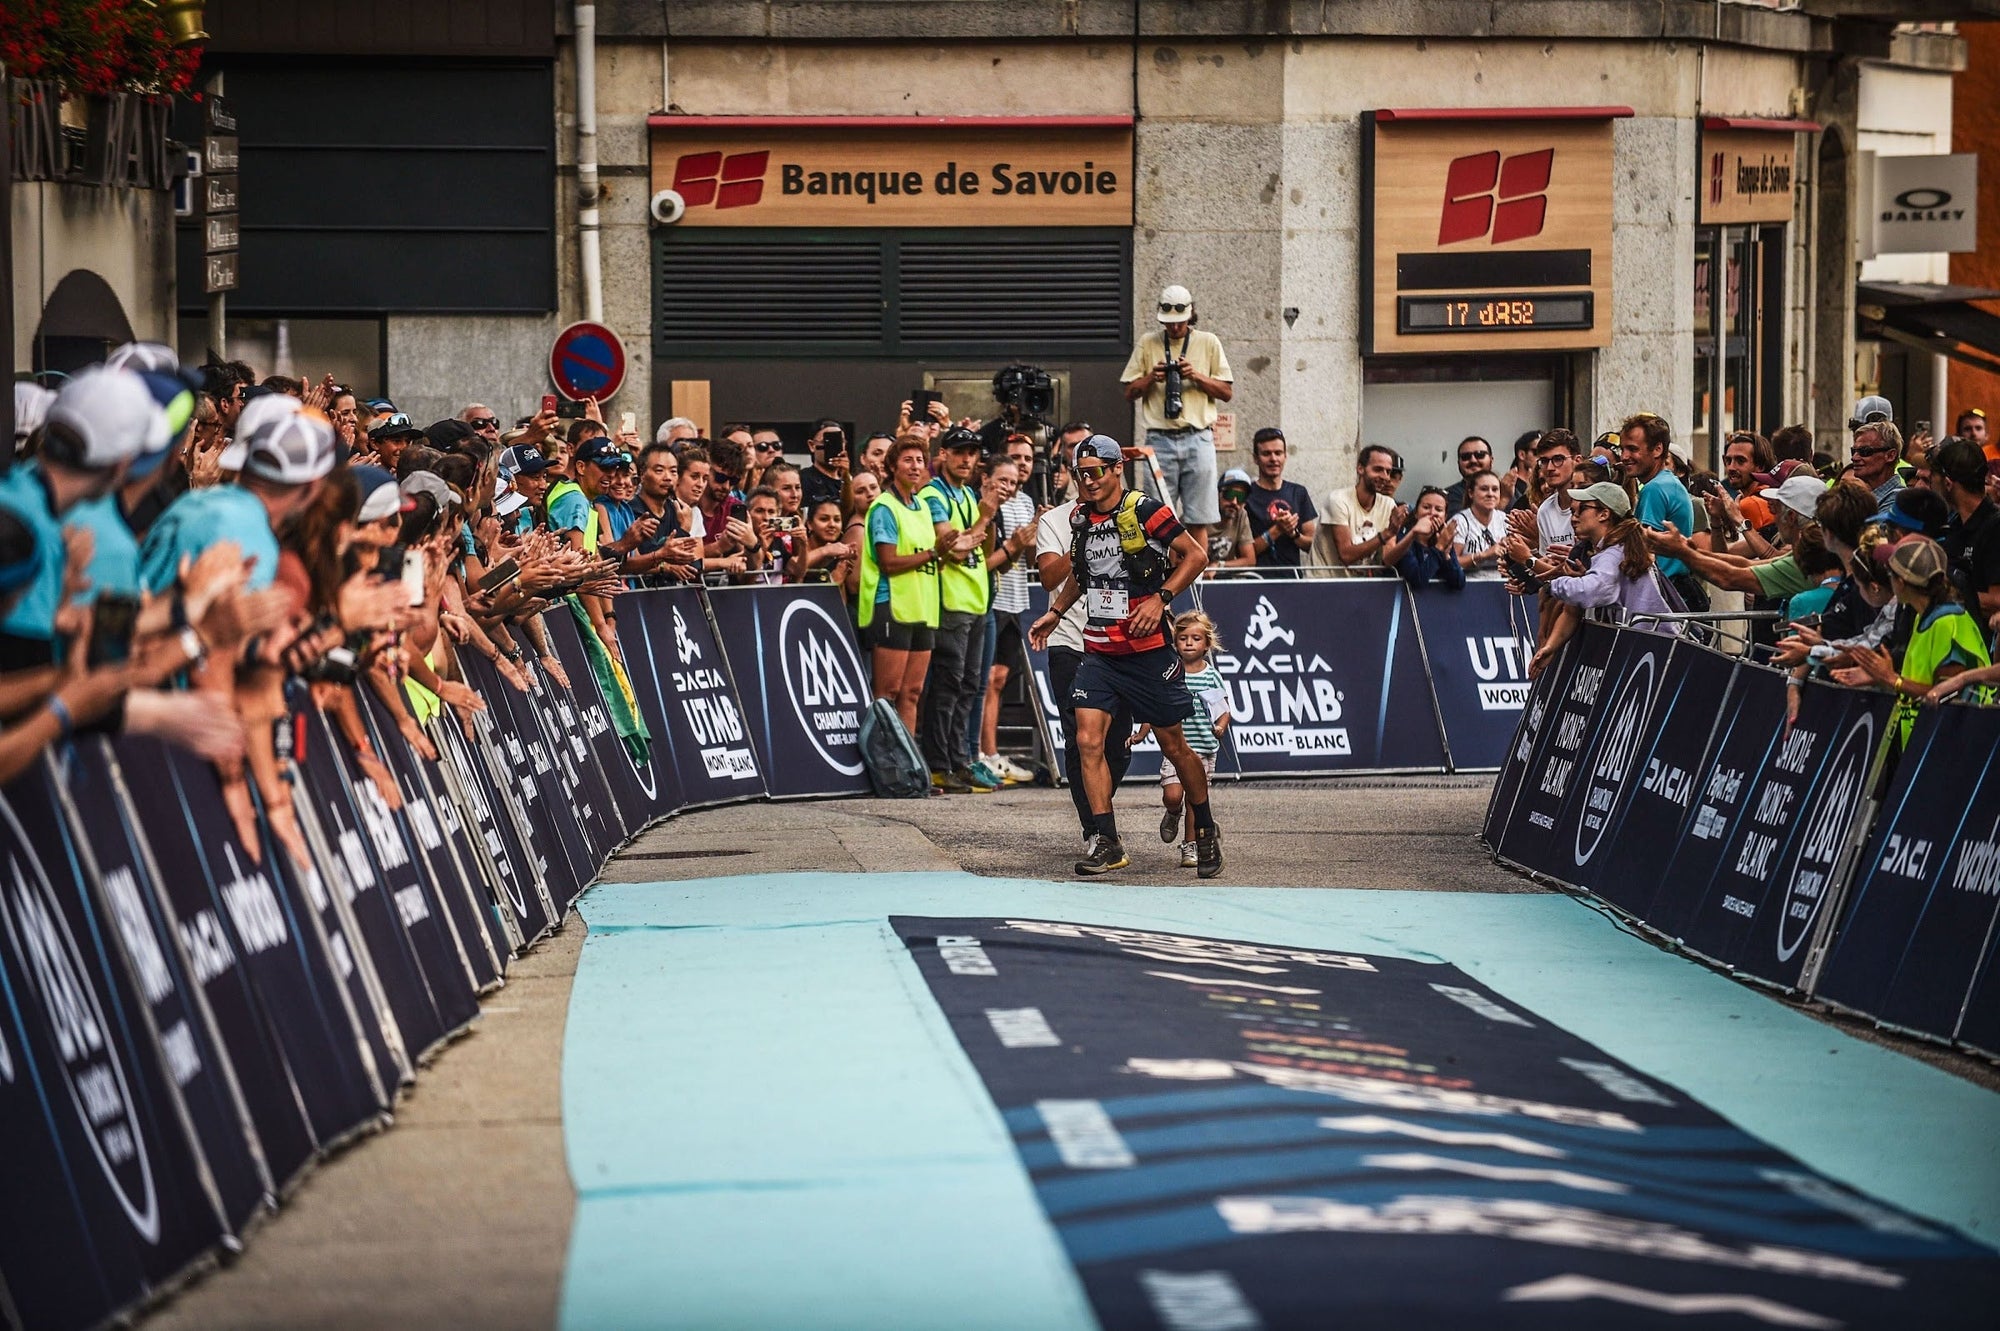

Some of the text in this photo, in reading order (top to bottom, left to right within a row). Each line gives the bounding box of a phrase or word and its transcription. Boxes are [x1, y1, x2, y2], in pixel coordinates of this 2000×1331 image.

[782, 162, 1117, 204] Banque de Savoie
[1881, 210, 1965, 221] OAKLEY
[1446, 302, 1470, 326] 17
[1102, 595, 1112, 604] 70
[1216, 653, 1334, 674] DACIA
[671, 668, 726, 693] DACIA
[1484, 688, 1530, 704] WORL
[813, 710, 860, 730] CHAMONIX
[1643, 757, 1692, 807] DACIA
[1735, 831, 1777, 882] BLANC
[1880, 834, 1932, 880] DACI
